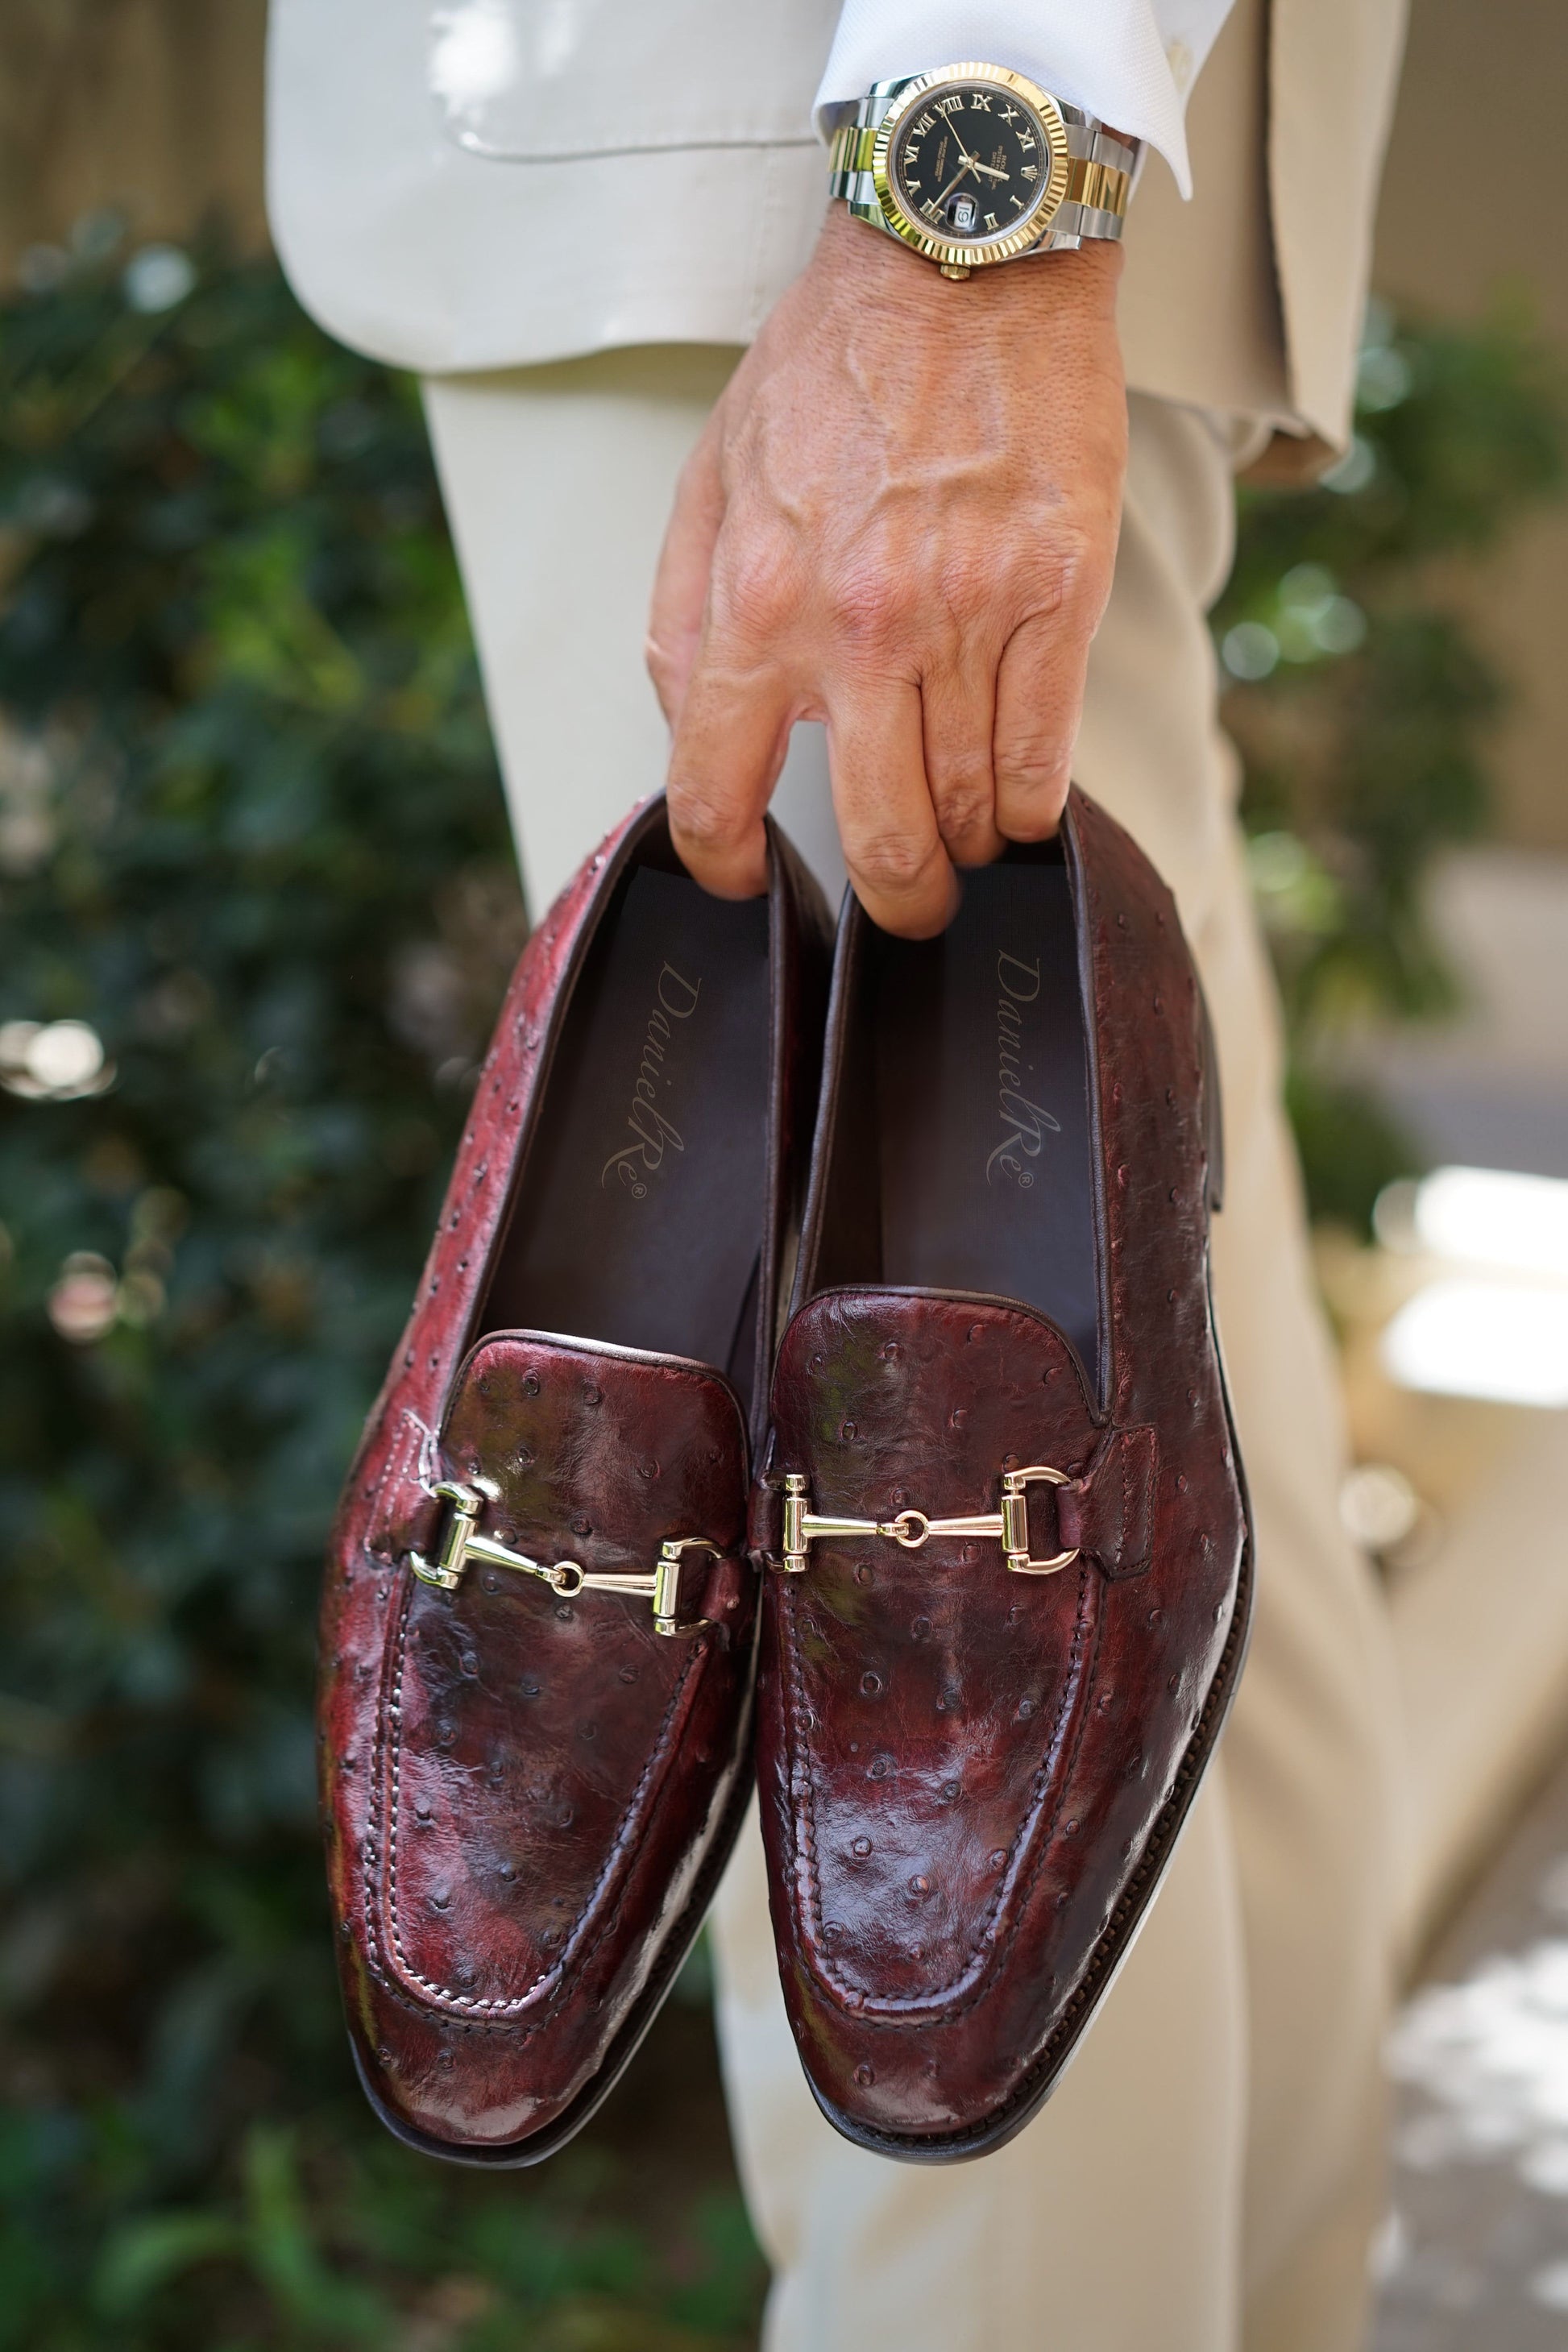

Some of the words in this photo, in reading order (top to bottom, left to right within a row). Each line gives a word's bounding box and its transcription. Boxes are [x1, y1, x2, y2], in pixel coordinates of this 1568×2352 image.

[970, 93, 994, 112] IX
[913, 113, 936, 138] VII
[998, 104, 1020, 127] X
[1015, 127, 1036, 153] XI
[906, 179, 921, 197] V
[984, 212, 999, 230] II
